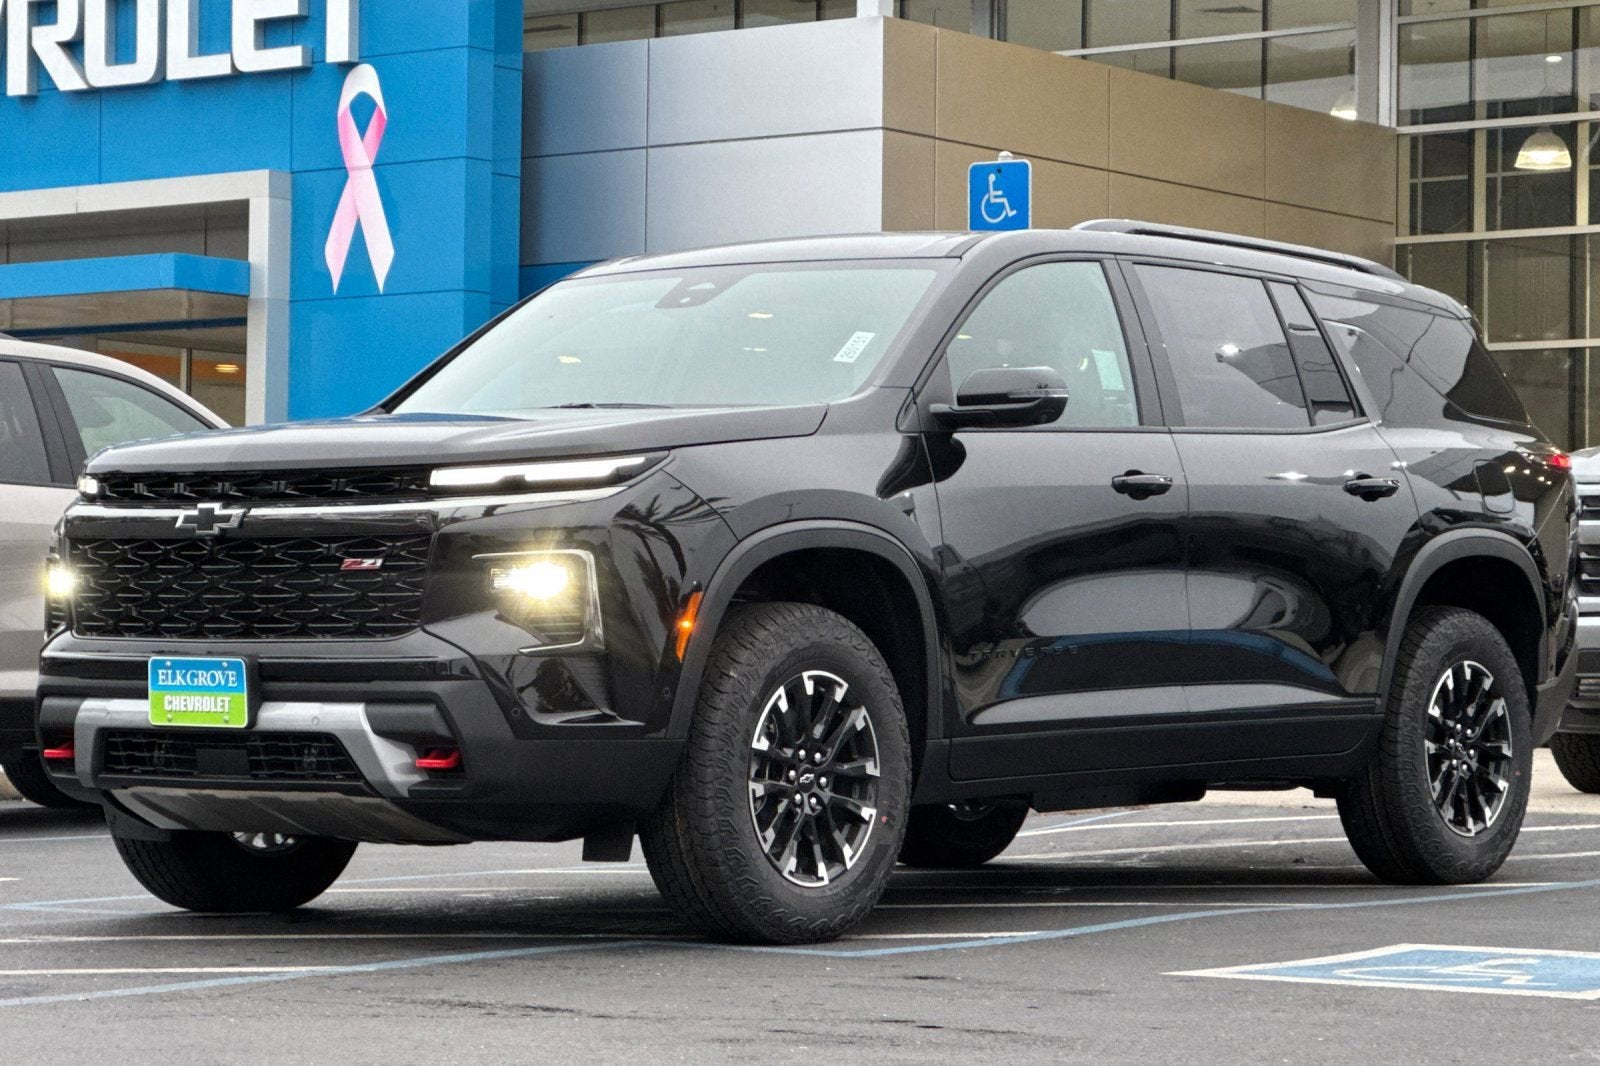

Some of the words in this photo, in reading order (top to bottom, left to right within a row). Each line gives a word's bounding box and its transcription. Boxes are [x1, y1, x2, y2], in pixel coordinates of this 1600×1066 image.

[157, 669, 187, 686] ELK
[187, 670, 238, 687] GROVE
[164, 695, 231, 713] CHEVROLET
